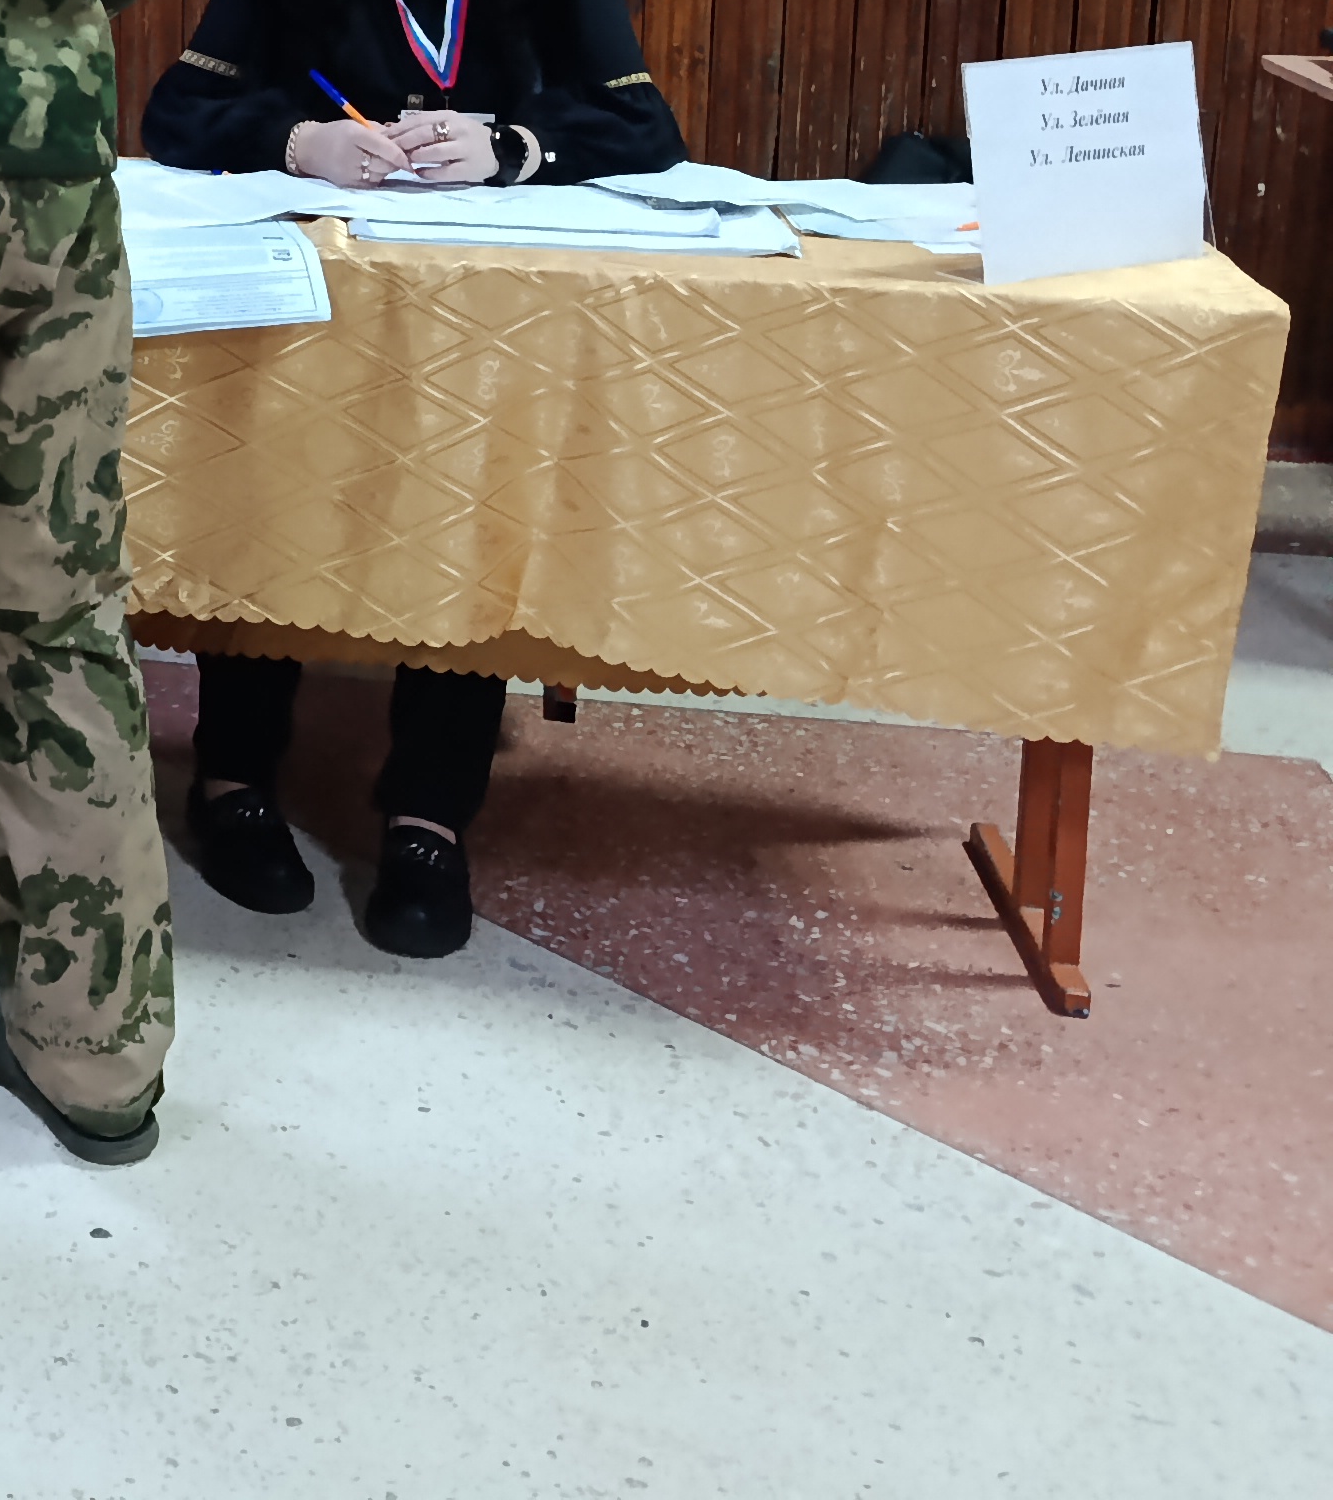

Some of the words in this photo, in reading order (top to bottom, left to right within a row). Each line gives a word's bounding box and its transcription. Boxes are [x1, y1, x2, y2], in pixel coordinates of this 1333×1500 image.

[1040, 77, 1064, 95] Ул.
[1067, 76, 1126, 96] Дачная
[1041, 112, 1064, 131] Ул.
[1069, 109, 1130, 128] Зелёная
[1029, 149, 1053, 167] Ул.
[1061, 145, 1146, 164] Ленинская
